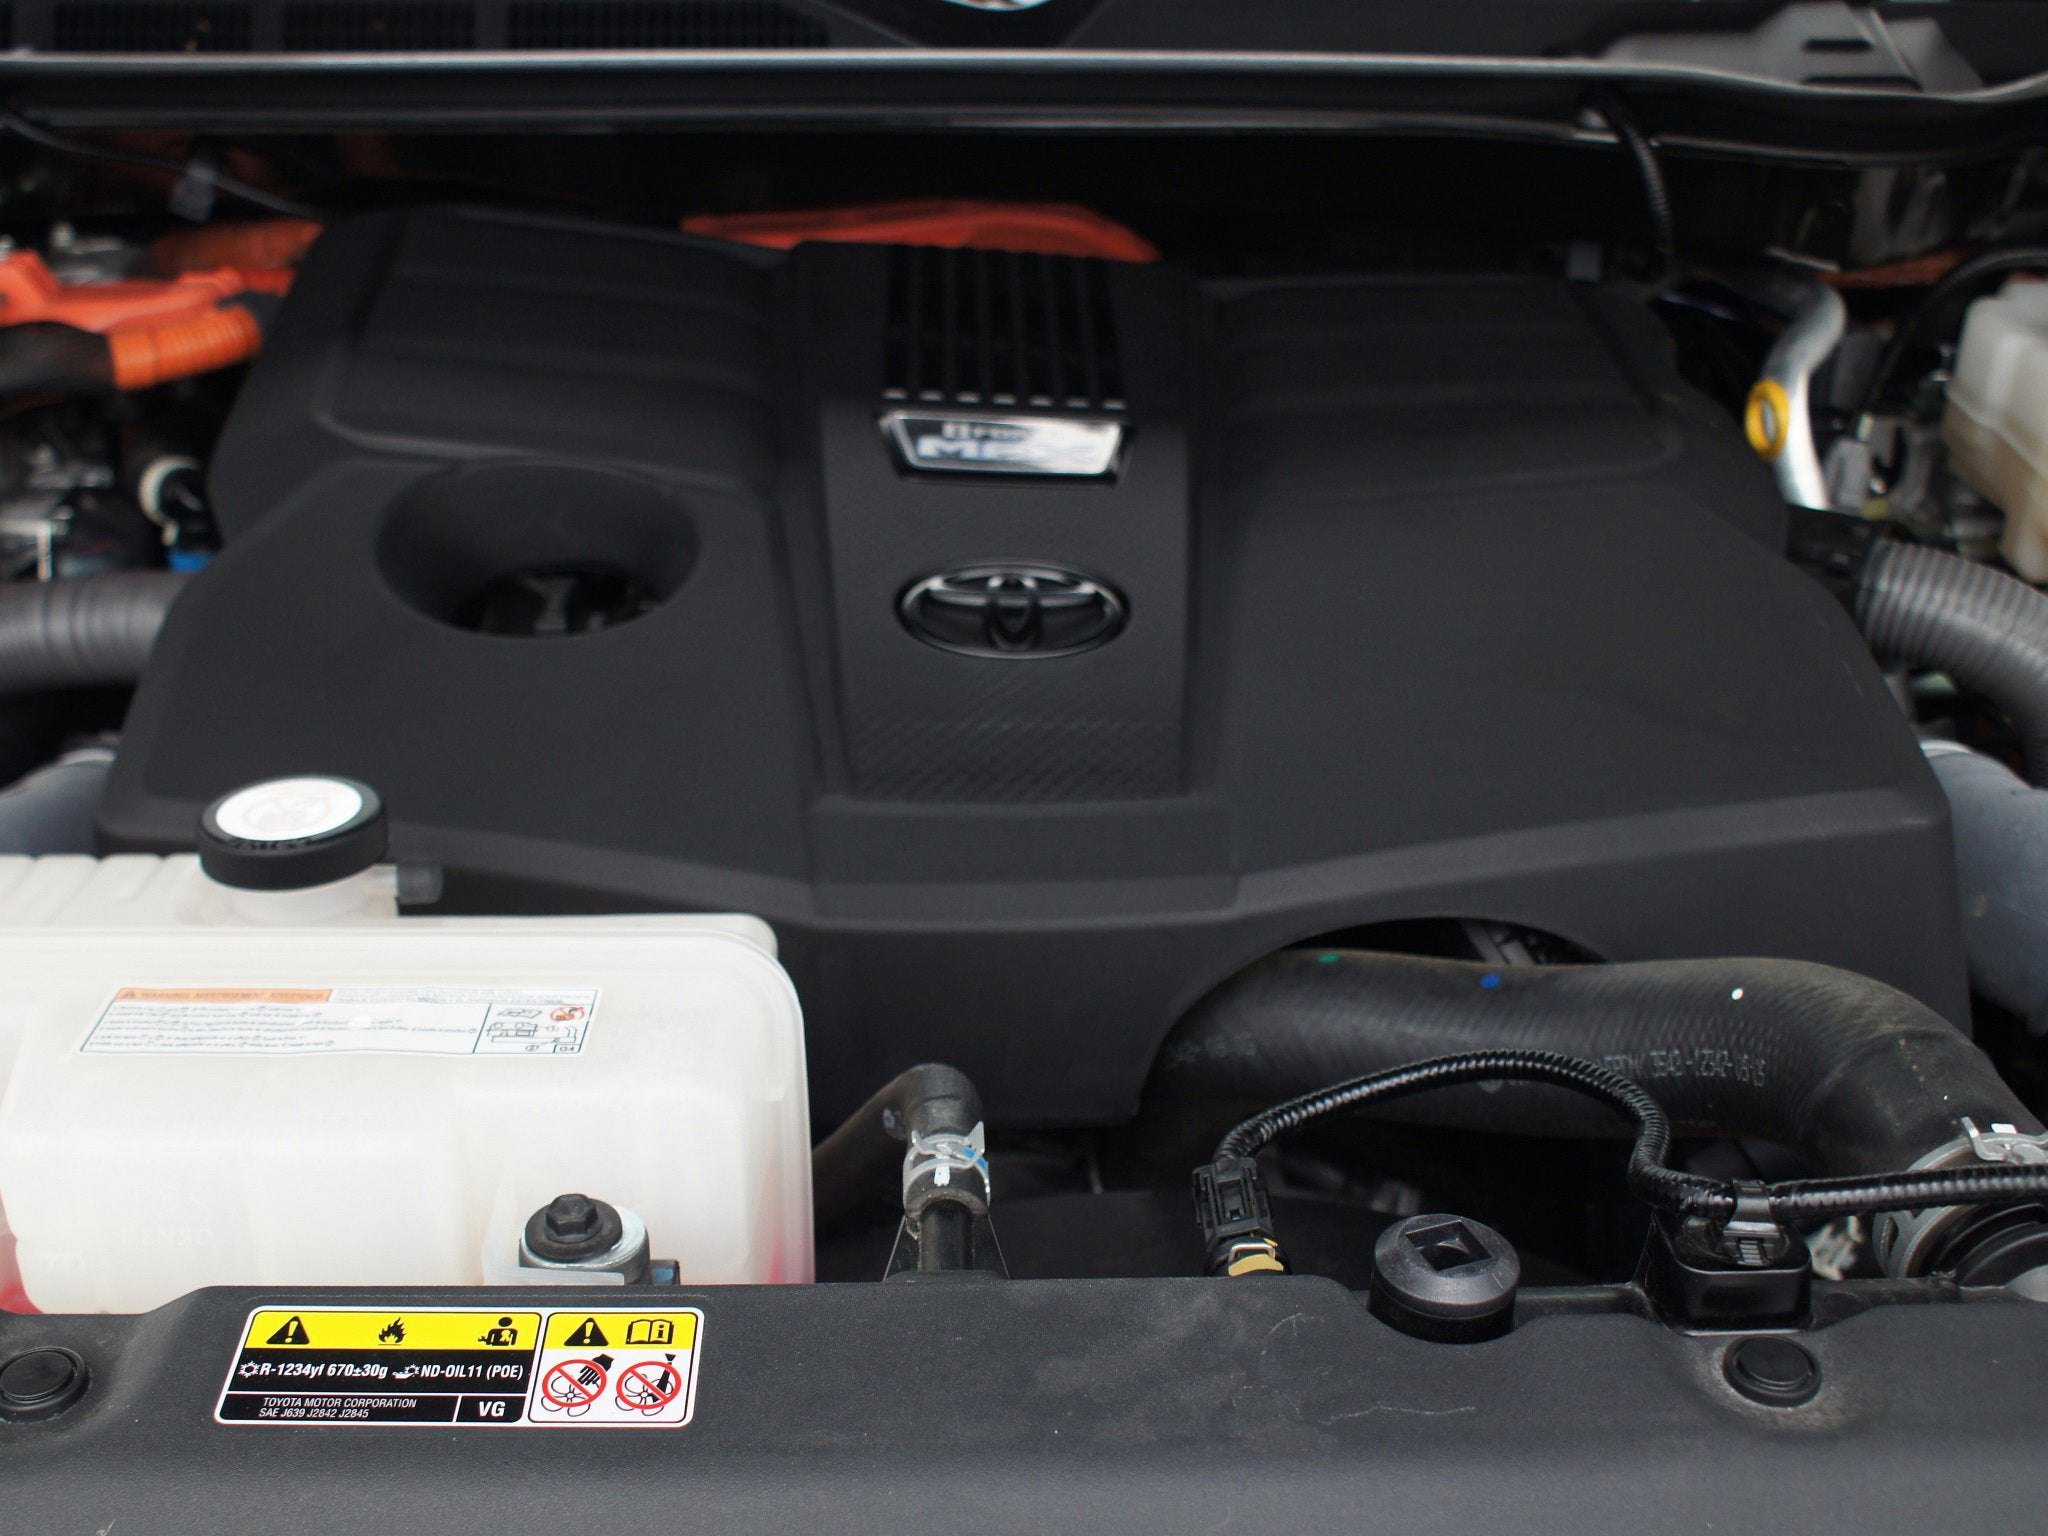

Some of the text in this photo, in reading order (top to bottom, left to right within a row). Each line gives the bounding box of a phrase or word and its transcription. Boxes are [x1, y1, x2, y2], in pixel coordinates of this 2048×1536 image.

[259, 1362, 524, 1381] R-1234yf 670±30g ND-OIL11 (POE)
[263, 1397, 418, 1408] TOYOTA MOTOR CORPORATION
[478, 1400, 506, 1418] VG
[258, 1407, 369, 1419] SAE J639 J2842 J2845
